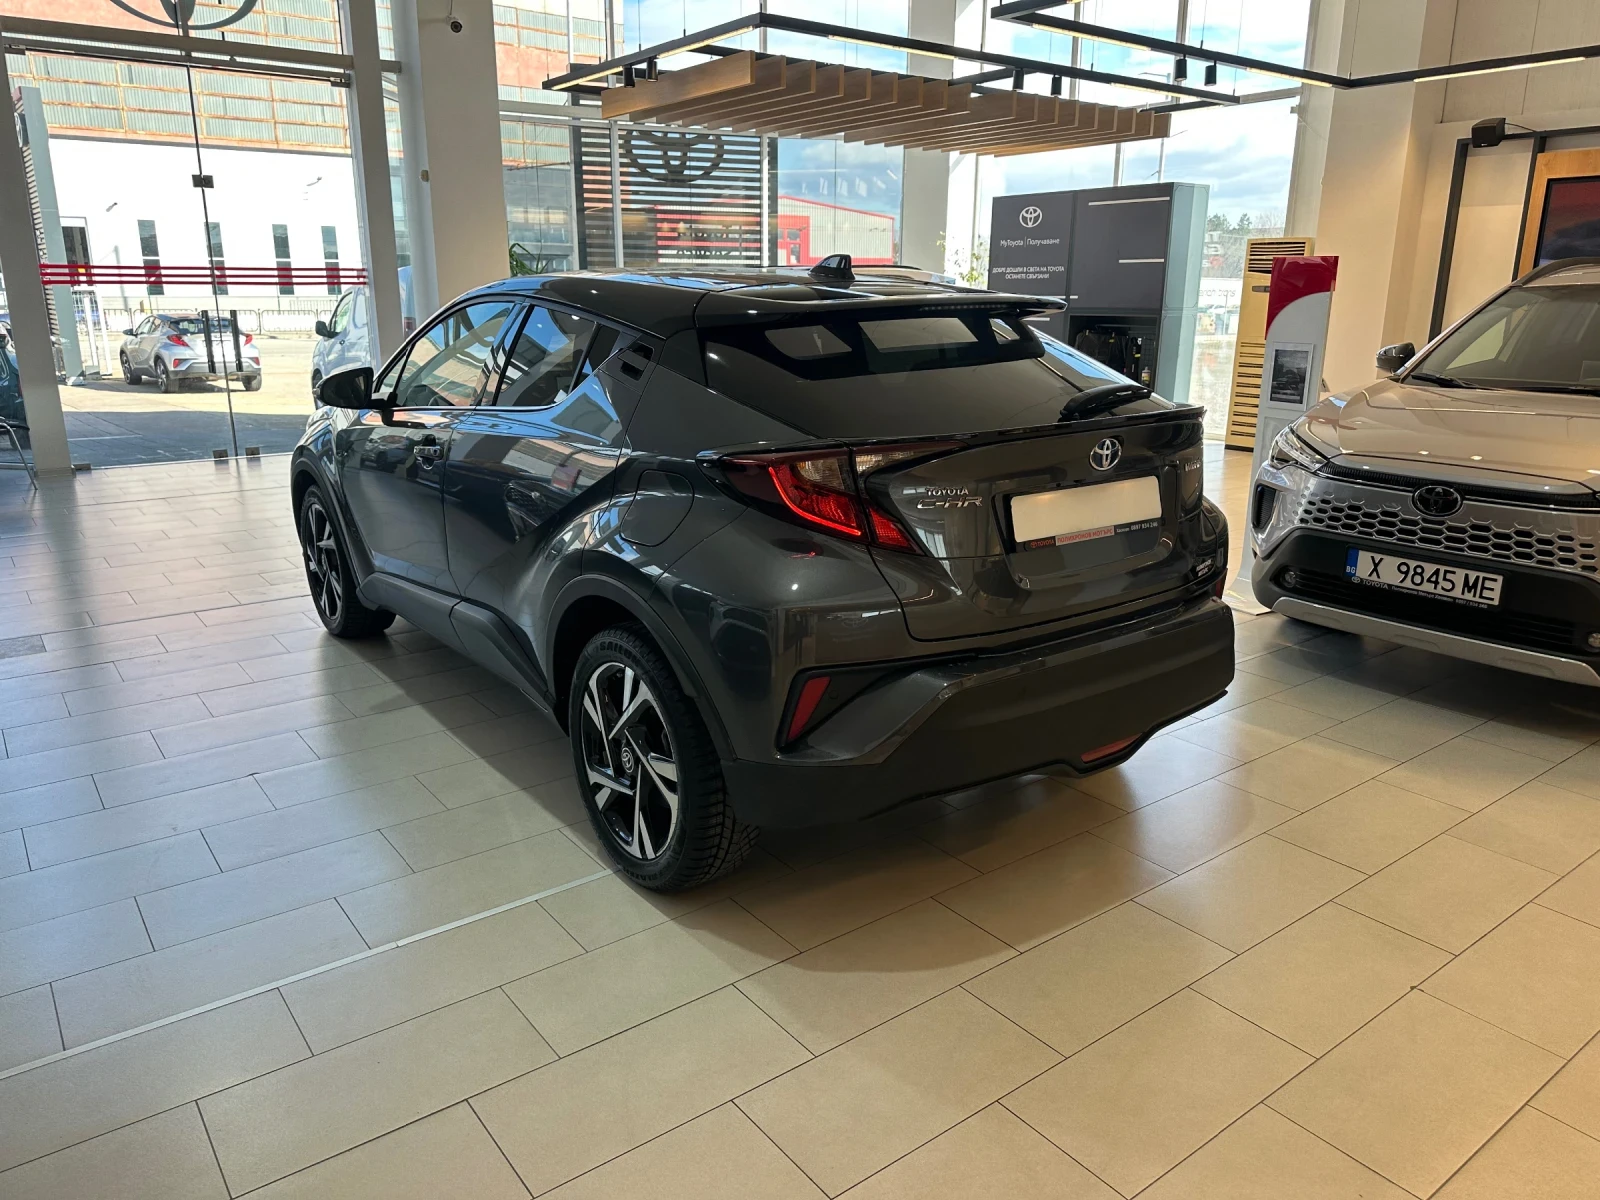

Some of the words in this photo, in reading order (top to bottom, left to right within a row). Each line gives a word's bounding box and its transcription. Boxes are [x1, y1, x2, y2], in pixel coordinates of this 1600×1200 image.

[1000, 239, 1023, 247] MyToyota
[1027, 238, 1060, 247] Получаване
[992, 266, 1006, 274] ДОБРЕ
[926, 486, 969, 496] TOYOTA
[917, 496, 983, 509] C-HR
[1057, 531, 1092, 543] ПОЛИХРОНОВ
[1092, 529, 1113, 538] МОТЪРС
[1037, 538, 1055, 547] TOYOTA
[1345, 565, 1356, 574] BG
[1367, 555, 1384, 579] X
[1397, 561, 1456, 593] 9845
[1461, 573, 1498, 602] ME
[1362, 580, 1389, 589] TOYOTA
